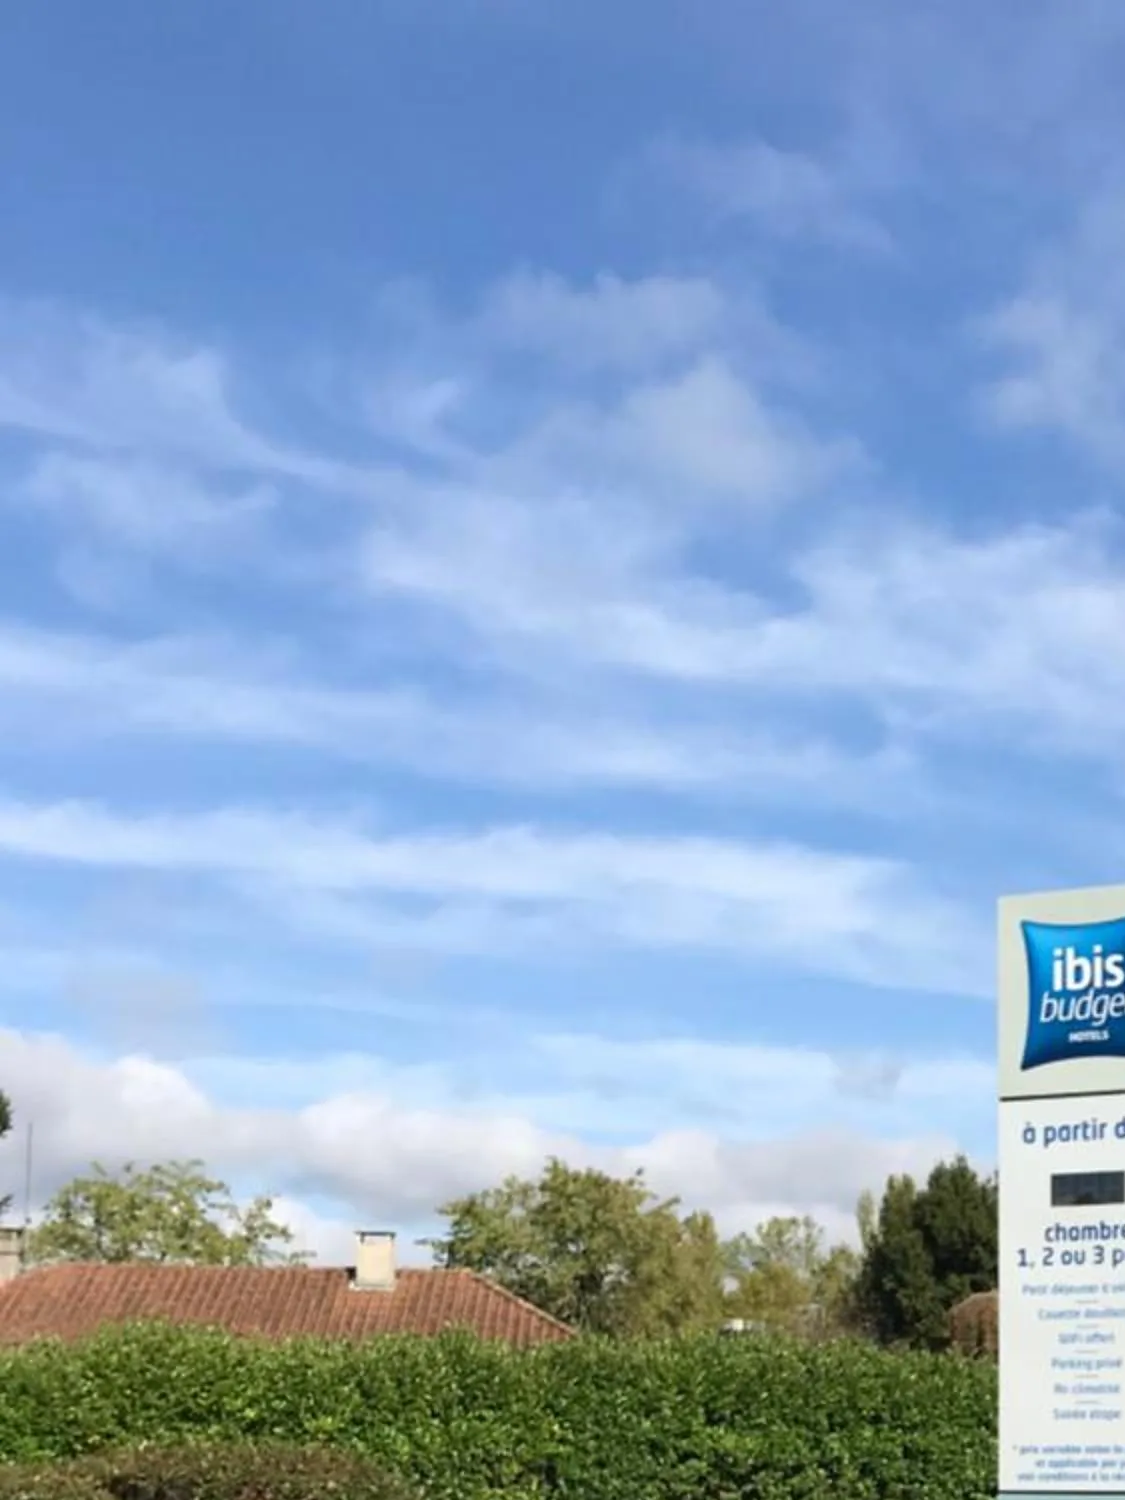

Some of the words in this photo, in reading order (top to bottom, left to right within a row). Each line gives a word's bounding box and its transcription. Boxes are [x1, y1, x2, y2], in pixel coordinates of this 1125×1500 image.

[1053, 944, 1125, 991] ibis
[1043, 1118, 1107, 1148] partir
[1042, 1247, 1055, 1266] 2
[1060, 1250, 1086, 1266] ou
[1093, 1245, 1105, 1265] 3
